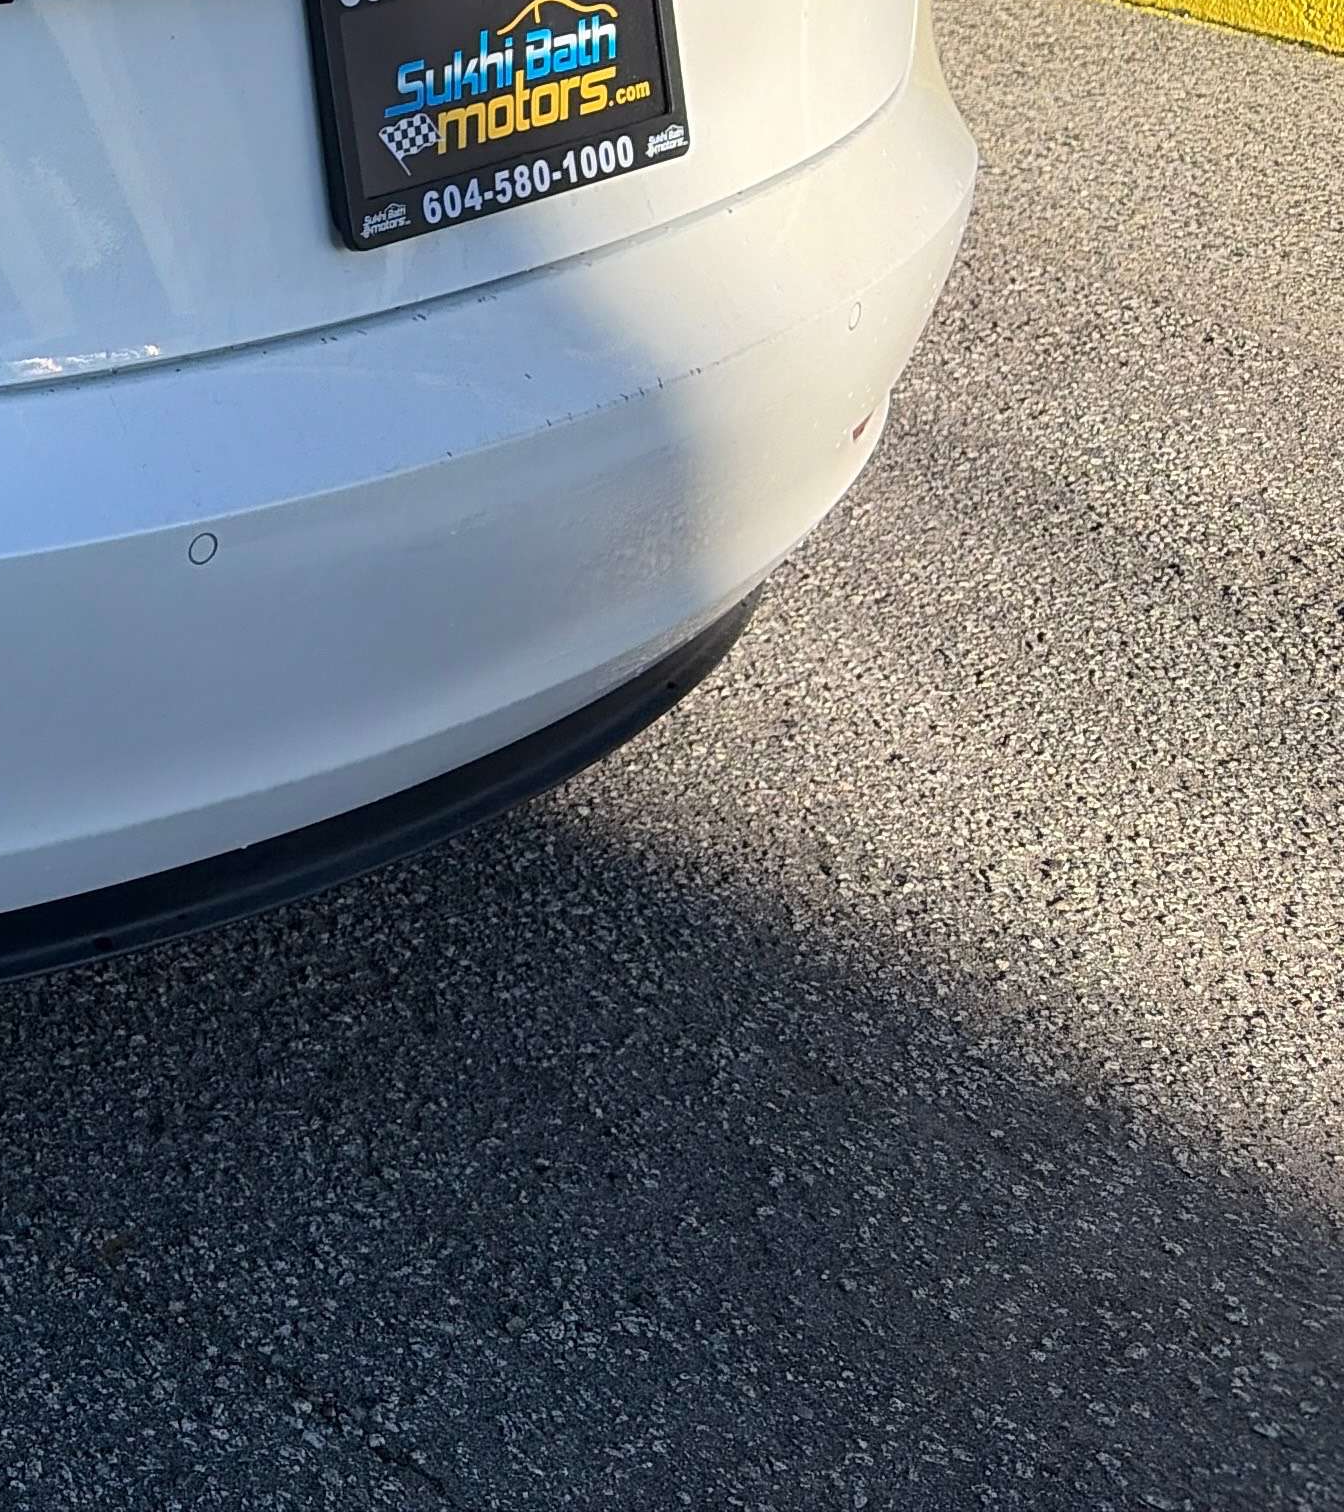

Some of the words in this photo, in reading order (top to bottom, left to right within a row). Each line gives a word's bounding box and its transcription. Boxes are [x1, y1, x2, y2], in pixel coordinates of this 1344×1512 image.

[384, 29, 515, 118] Sukhi
[525, 14, 617, 81] Bath
[423, 134, 635, 224] 604-580-1000
